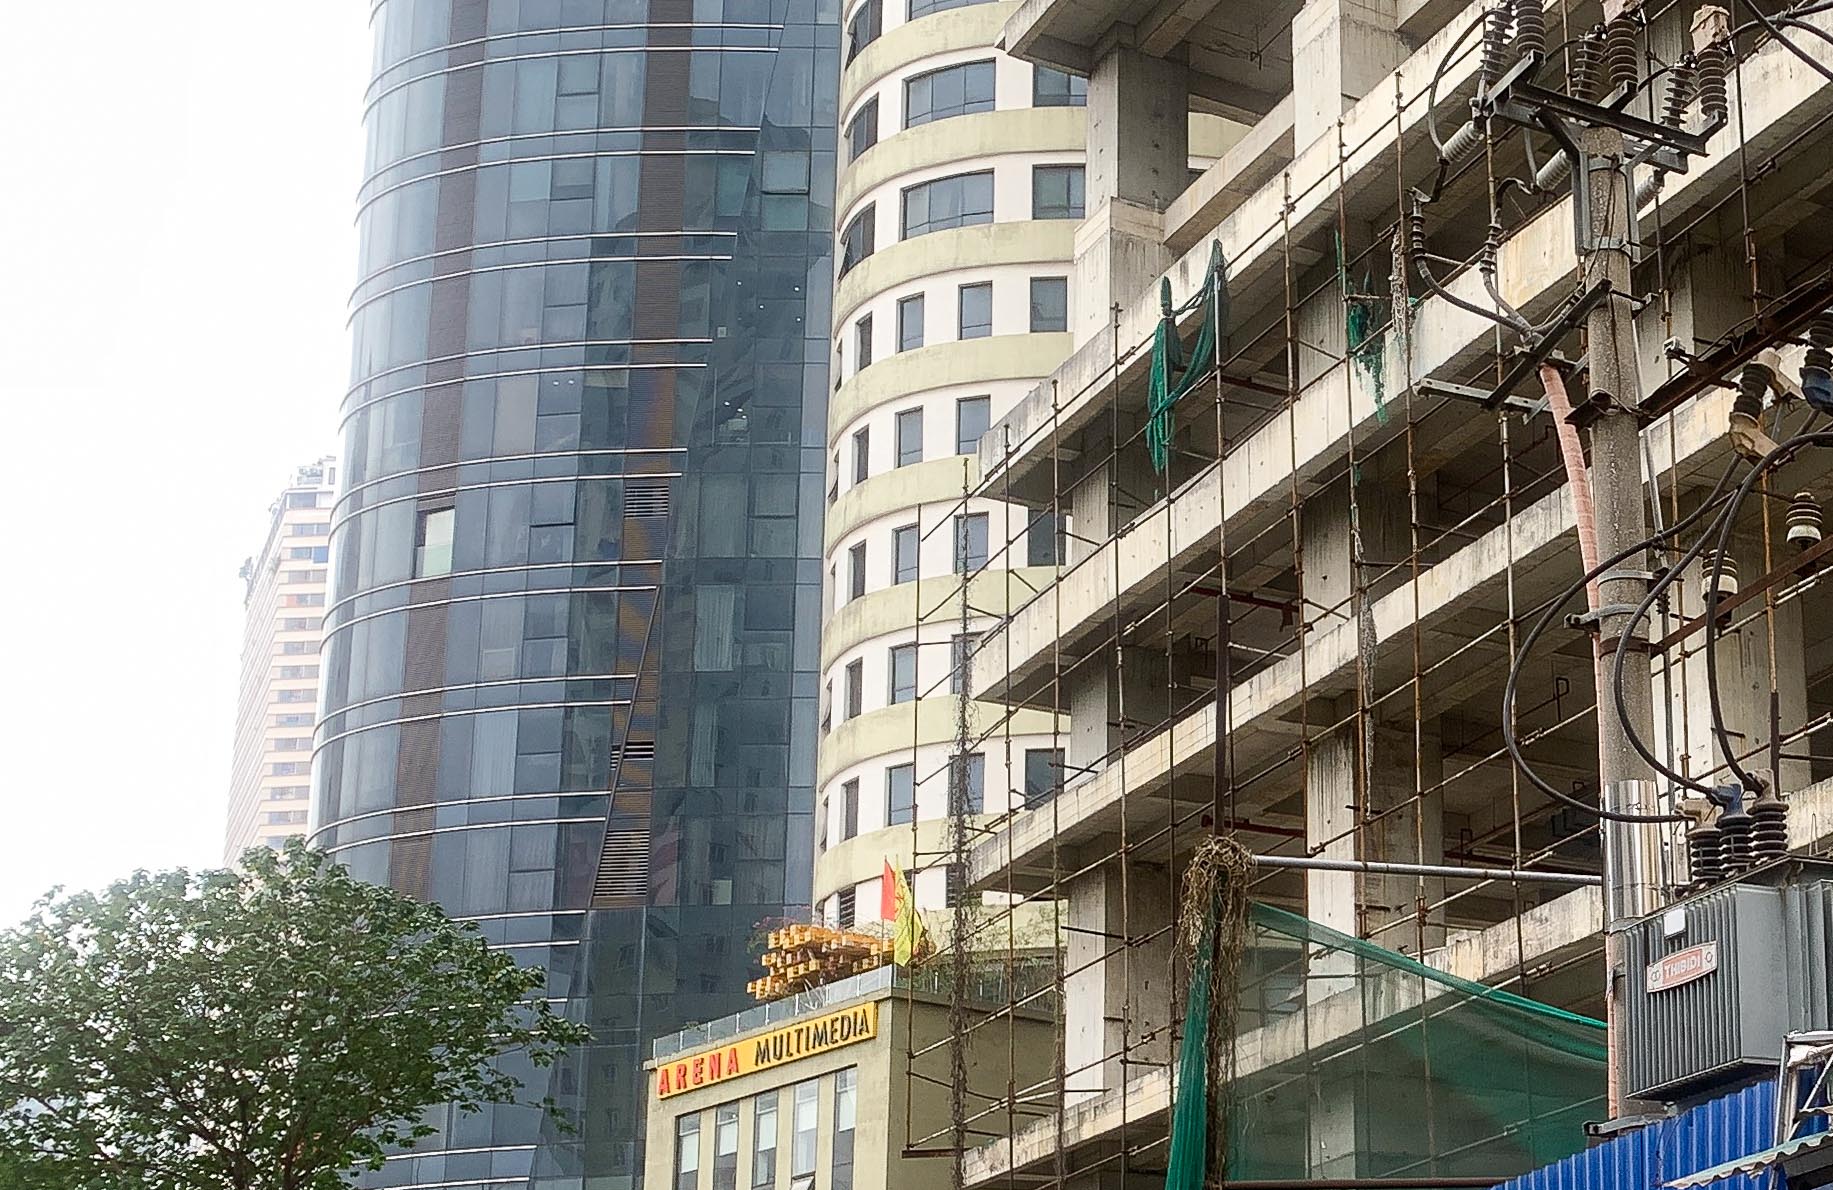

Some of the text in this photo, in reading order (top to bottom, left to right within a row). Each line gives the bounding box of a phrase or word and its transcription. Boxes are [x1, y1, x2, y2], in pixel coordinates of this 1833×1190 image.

[1664, 954, 1702, 979] THIBIDI
[657, 1007, 870, 1096] ARENA MULTIMEDIA
